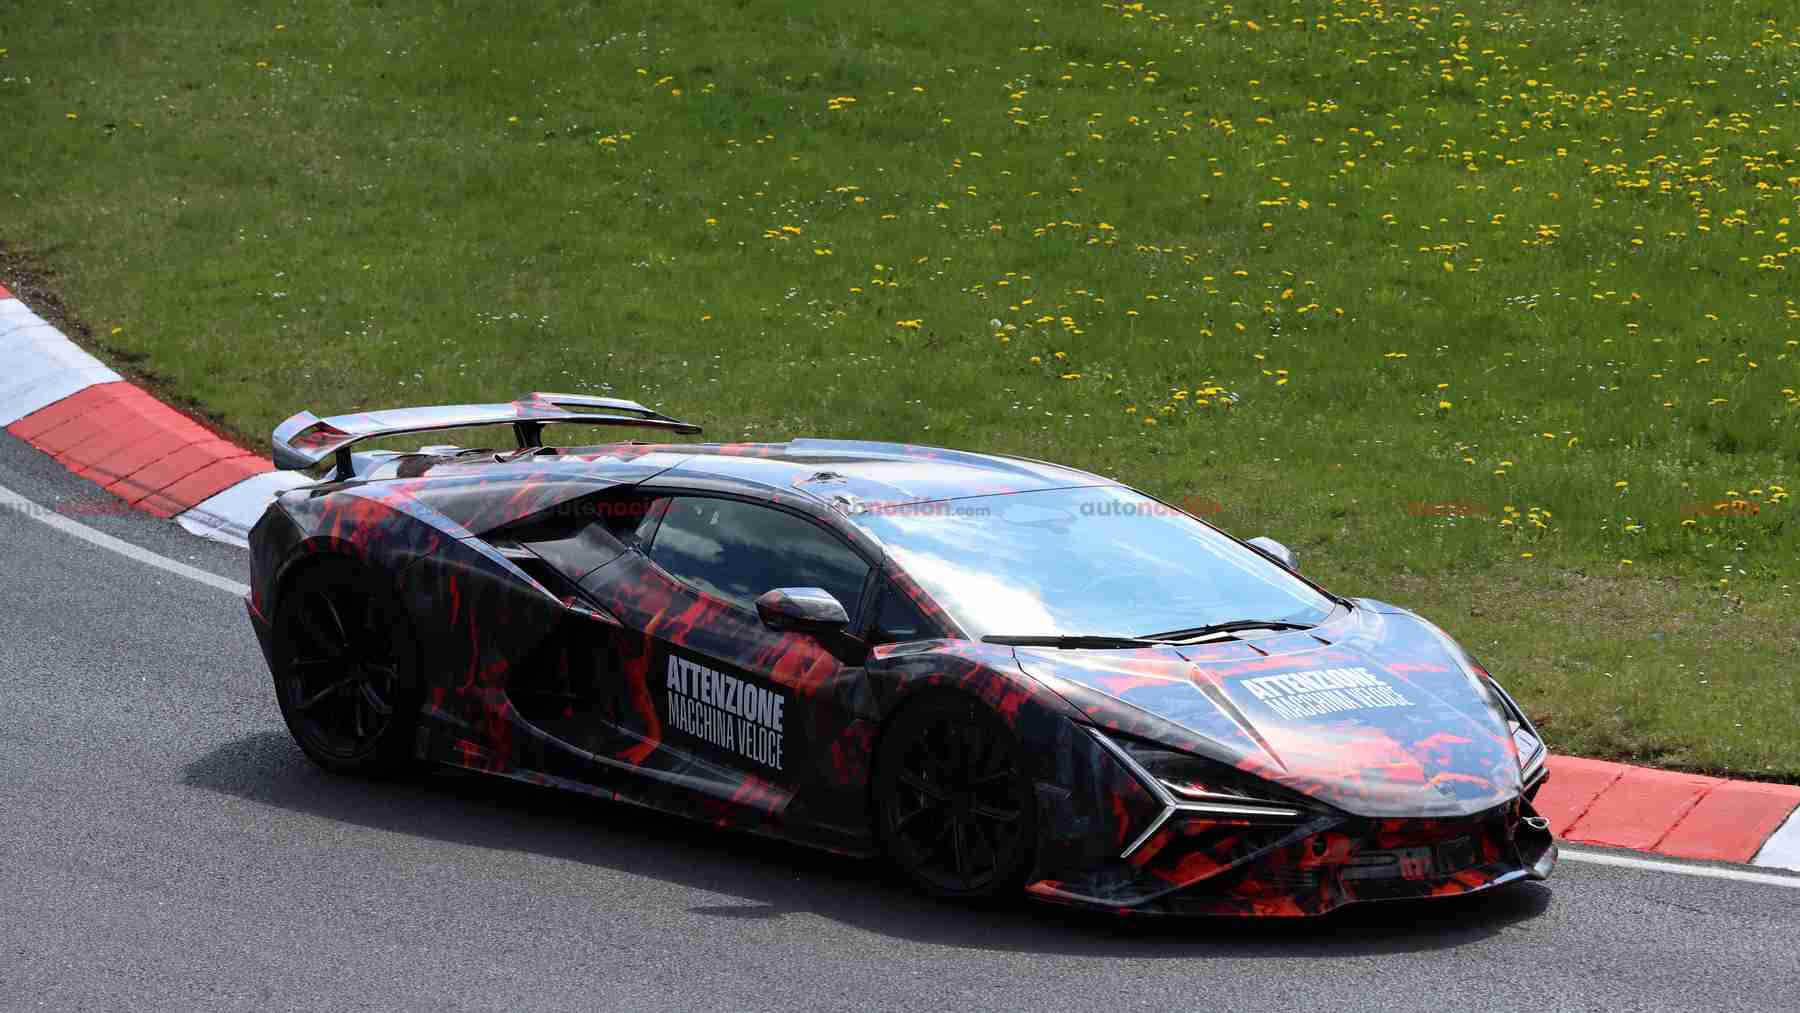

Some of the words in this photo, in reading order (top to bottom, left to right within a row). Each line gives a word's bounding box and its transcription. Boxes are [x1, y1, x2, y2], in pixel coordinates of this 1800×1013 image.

[666, 654, 785, 732] ATTENZIONE
[1239, 667, 1387, 701] ATTENZIONE
[1263, 687, 1360, 720] MACCHINA
[1351, 686, 1416, 708] VELOCE
[667, 690, 735, 751] MACCHINA
[737, 717, 784, 771] VELOCE
